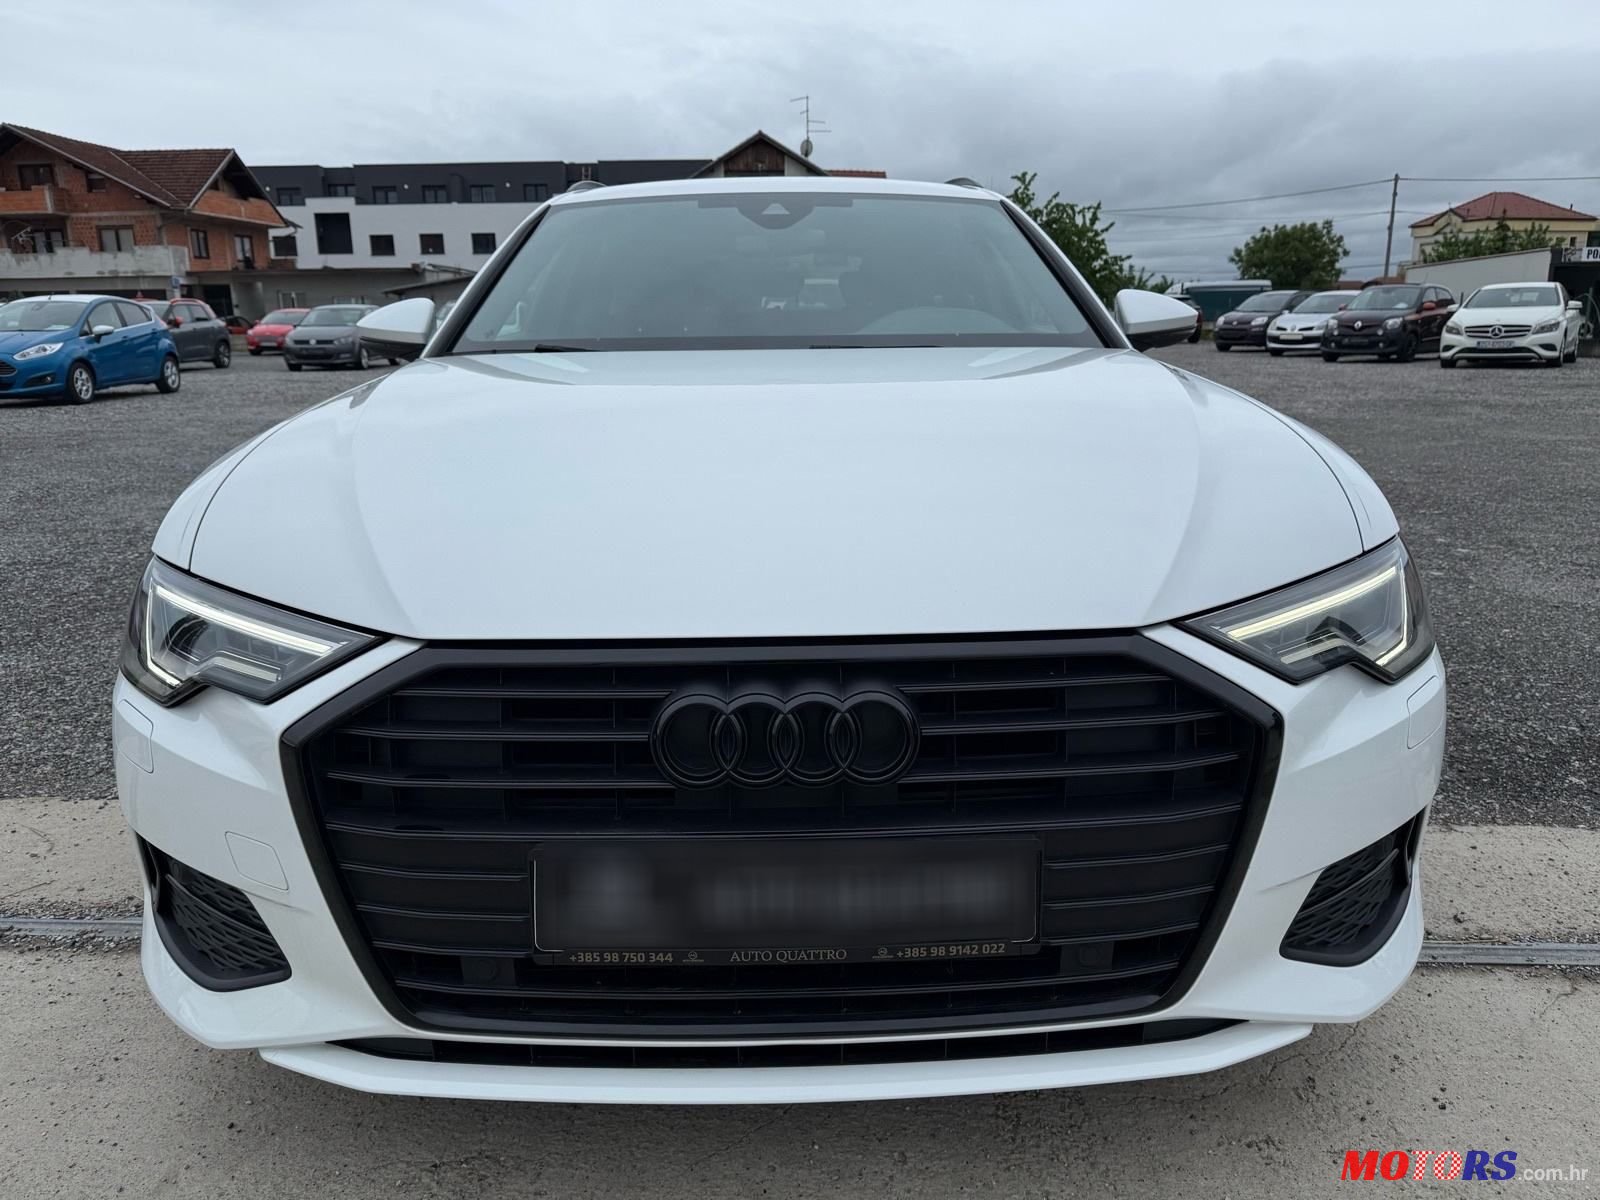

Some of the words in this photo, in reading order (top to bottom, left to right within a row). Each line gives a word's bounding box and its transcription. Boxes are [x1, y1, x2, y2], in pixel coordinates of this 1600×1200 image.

[1586, 248, 1600, 260] PO
[730, 951, 773, 962] AUTO
[776, 949, 848, 963] QUATTRO
[896, 947, 927, 958] +385
[930, 946, 946, 957] 98
[949, 944, 979, 956] 9142
[982, 943, 1006, 954] 022
[569, 952, 601, 963] +385
[603, 952, 620, 963] 98
[622, 952, 646, 963] 750
[648, 952, 673, 963] 344
